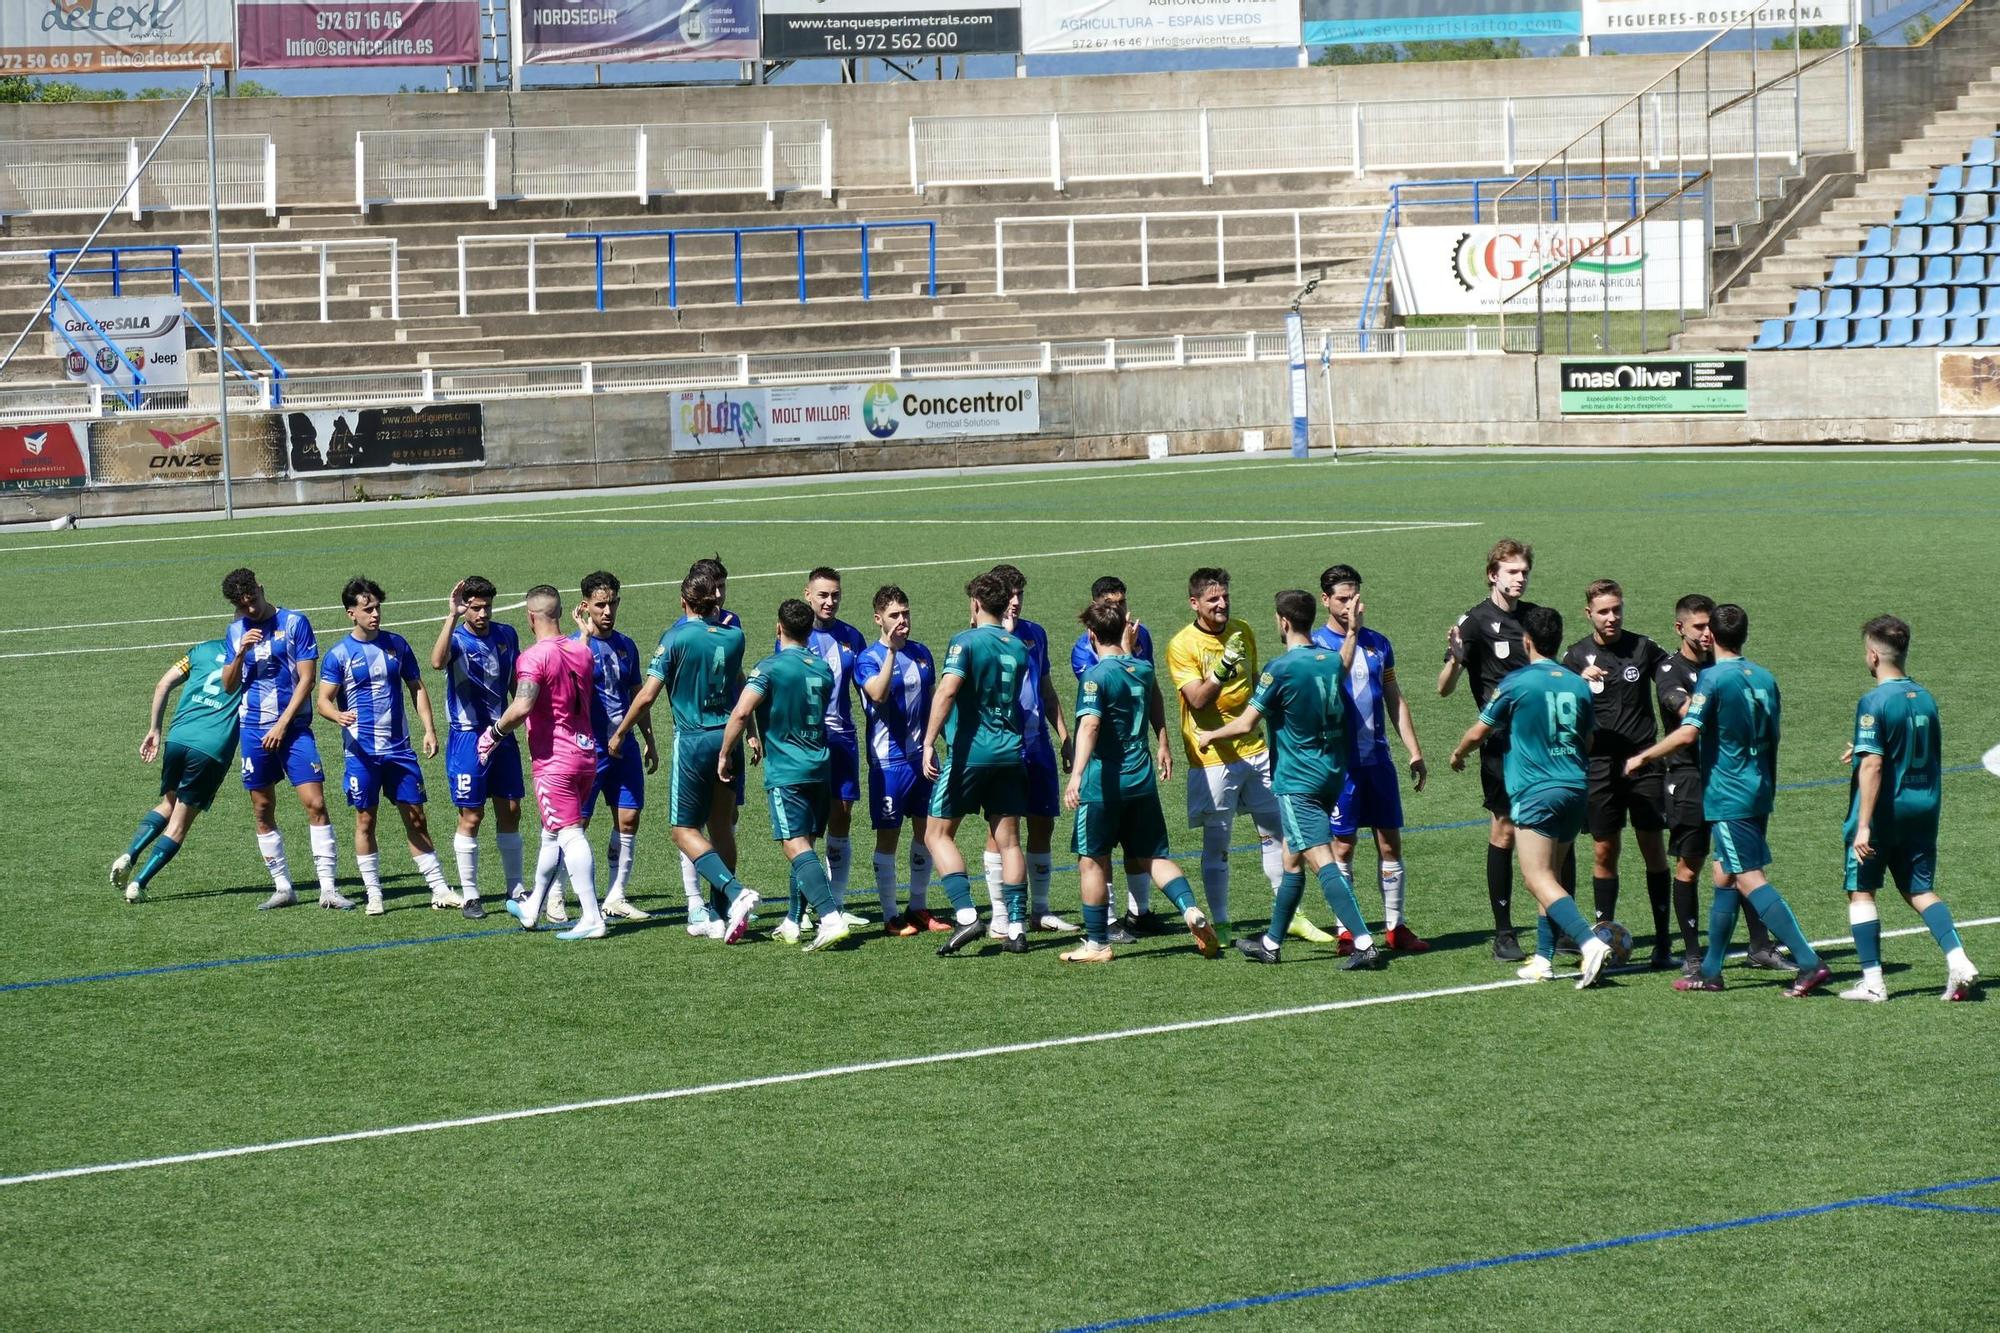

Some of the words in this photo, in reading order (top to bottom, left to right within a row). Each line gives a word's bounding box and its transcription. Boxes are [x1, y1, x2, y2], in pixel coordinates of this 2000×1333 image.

[42, 0, 174, 32] detext
[317, 12, 342, 29] 972
[345, 12, 362, 29] 67
[364, 12, 381, 28] 16
[383, 11, 402, 28] 46
[533, 9, 617, 25] NORDSEGUR
[789, 14, 993, 30] www.tanquesperimetrals.com
[1060, 17, 1152, 31] AGRICULTURA
[1168, 15, 1215, 27] ESPAIS
[1218, 13, 1262, 26] VERDS
[286, 37, 433, 57] Info@servicentre.es
[824, 35, 851, 50] Tel.
[855, 34, 887, 50] 972
[891, 33, 922, 49] 562
[926, 32, 958, 48] 600
[1072, 39, 1093, 49] 972
[1095, 38, 1109, 48] 67
[1113, 38, 1126, 47] 16
[1129, 37, 1142, 47] 46
[1152, 34, 1251, 46] info@servicentre.es
[0, 54, 21, 69] 72
[28, 54, 46, 68] 50
[50, 53, 69, 67] 60
[74, 52, 92, 67] 97
[101, 50, 222, 67] info@detext.cat
[1484, 233, 1642, 281] GARDELL
[150, 352, 178, 365] Jeep
[1569, 365, 1682, 388] masOliver
[902, 390, 1024, 417] Concentrol
[772, 407, 802, 424] MOLT
[805, 404, 851, 422] MILLOR!
[926, 419, 961, 428] Chemical
[963, 417, 1001, 427] Solutions
[148, 453, 223, 469] ONZE
[17, 478, 71, 489] VILATENIM
[805, 677, 823, 725] 5
[1545, 691, 1577, 743] 19
[349, 776, 358, 791] 9
[457, 773, 471, 790] 12
[883, 795, 893, 812] 3
